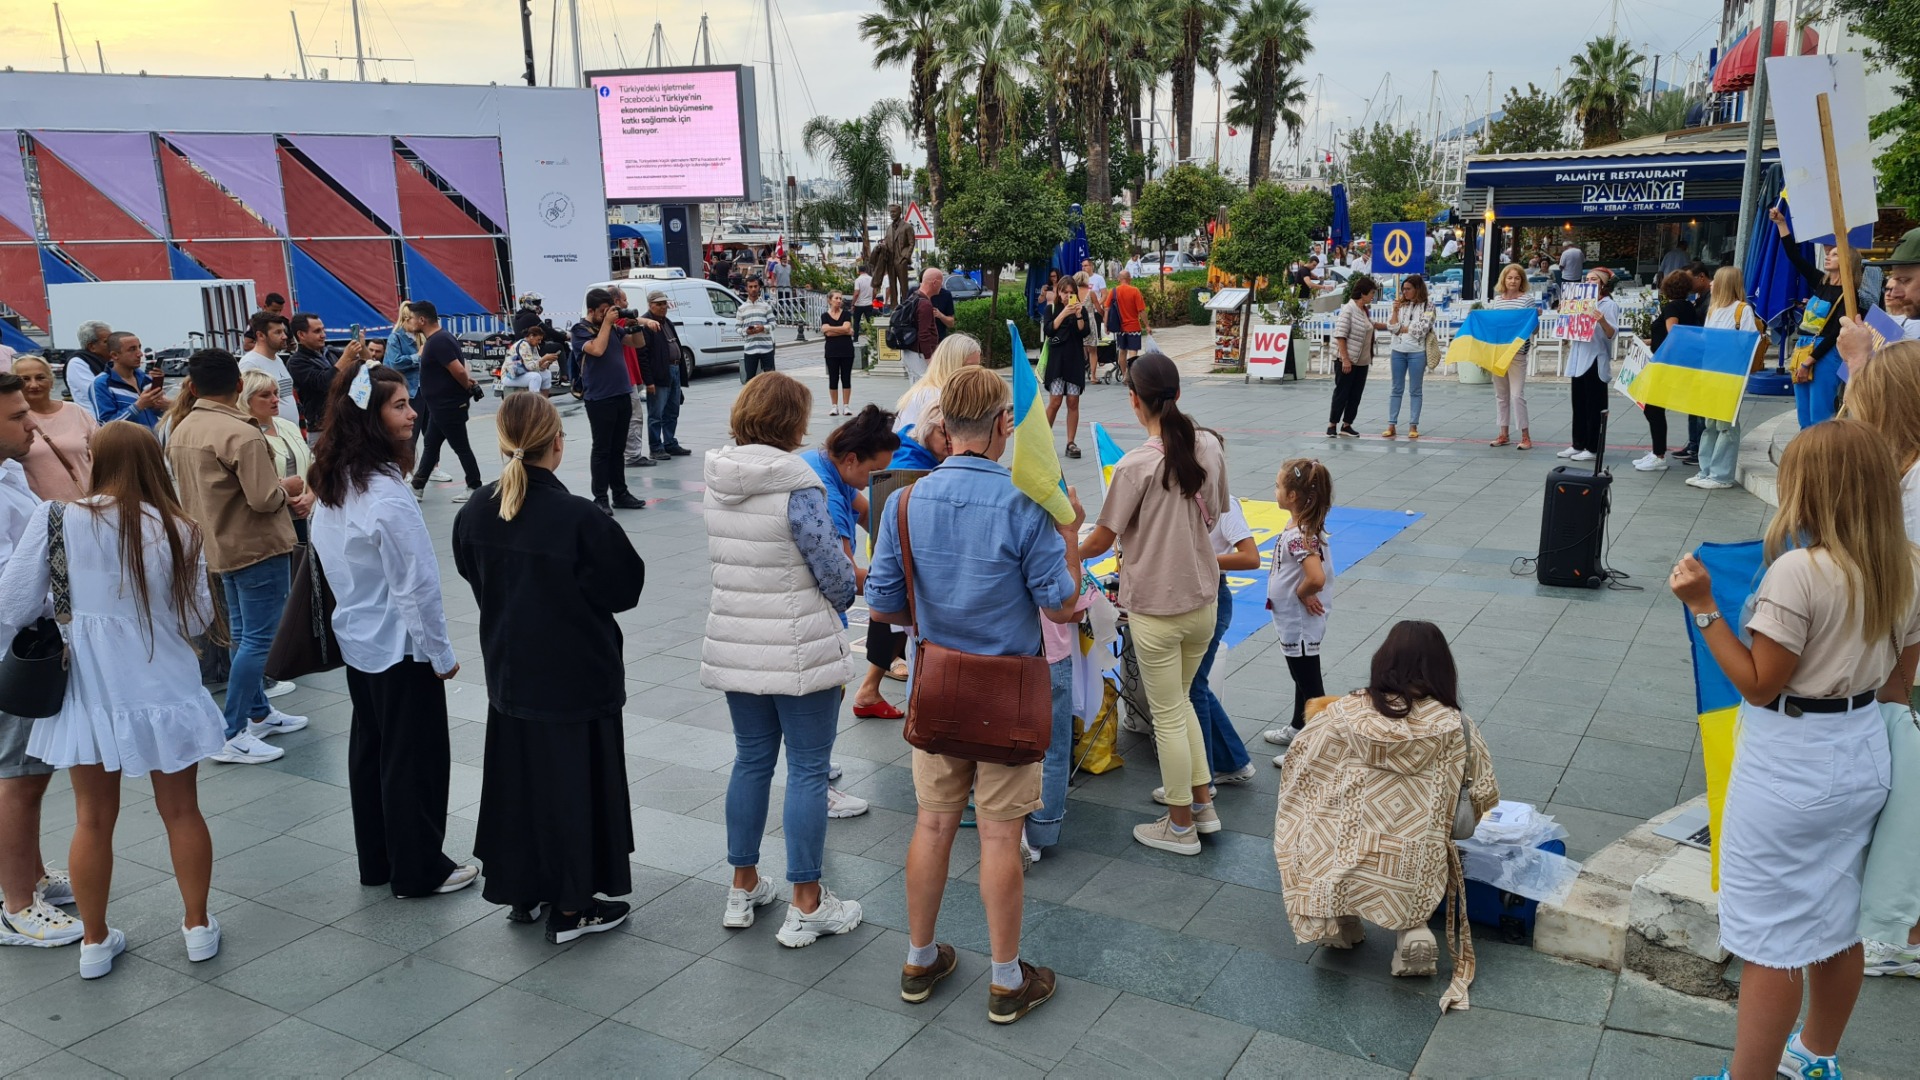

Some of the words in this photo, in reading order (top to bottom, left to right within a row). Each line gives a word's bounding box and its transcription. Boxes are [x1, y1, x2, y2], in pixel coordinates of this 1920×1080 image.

[619, 85, 660, 94] Türkiye'deki
[661, 83, 695, 93] işletmeler
[619, 95, 660, 103] Facebook'u
[661, 93, 702, 103] Türkiye'nin
[620, 105, 668, 114] ekonomisinin
[669, 103, 714, 114] büyümesine
[621, 116, 640, 124] katkı
[641, 115, 677, 125] sağlamak
[678, 115, 692, 125] için
[622, 127, 659, 136] kullanıyor.
[1555, 170, 1606, 181] PALMİYE
[1610, 169, 1688, 180] RESTAURANT
[1582, 180, 1684, 203] PALMİYE
[1254, 332, 1288, 352] WC
